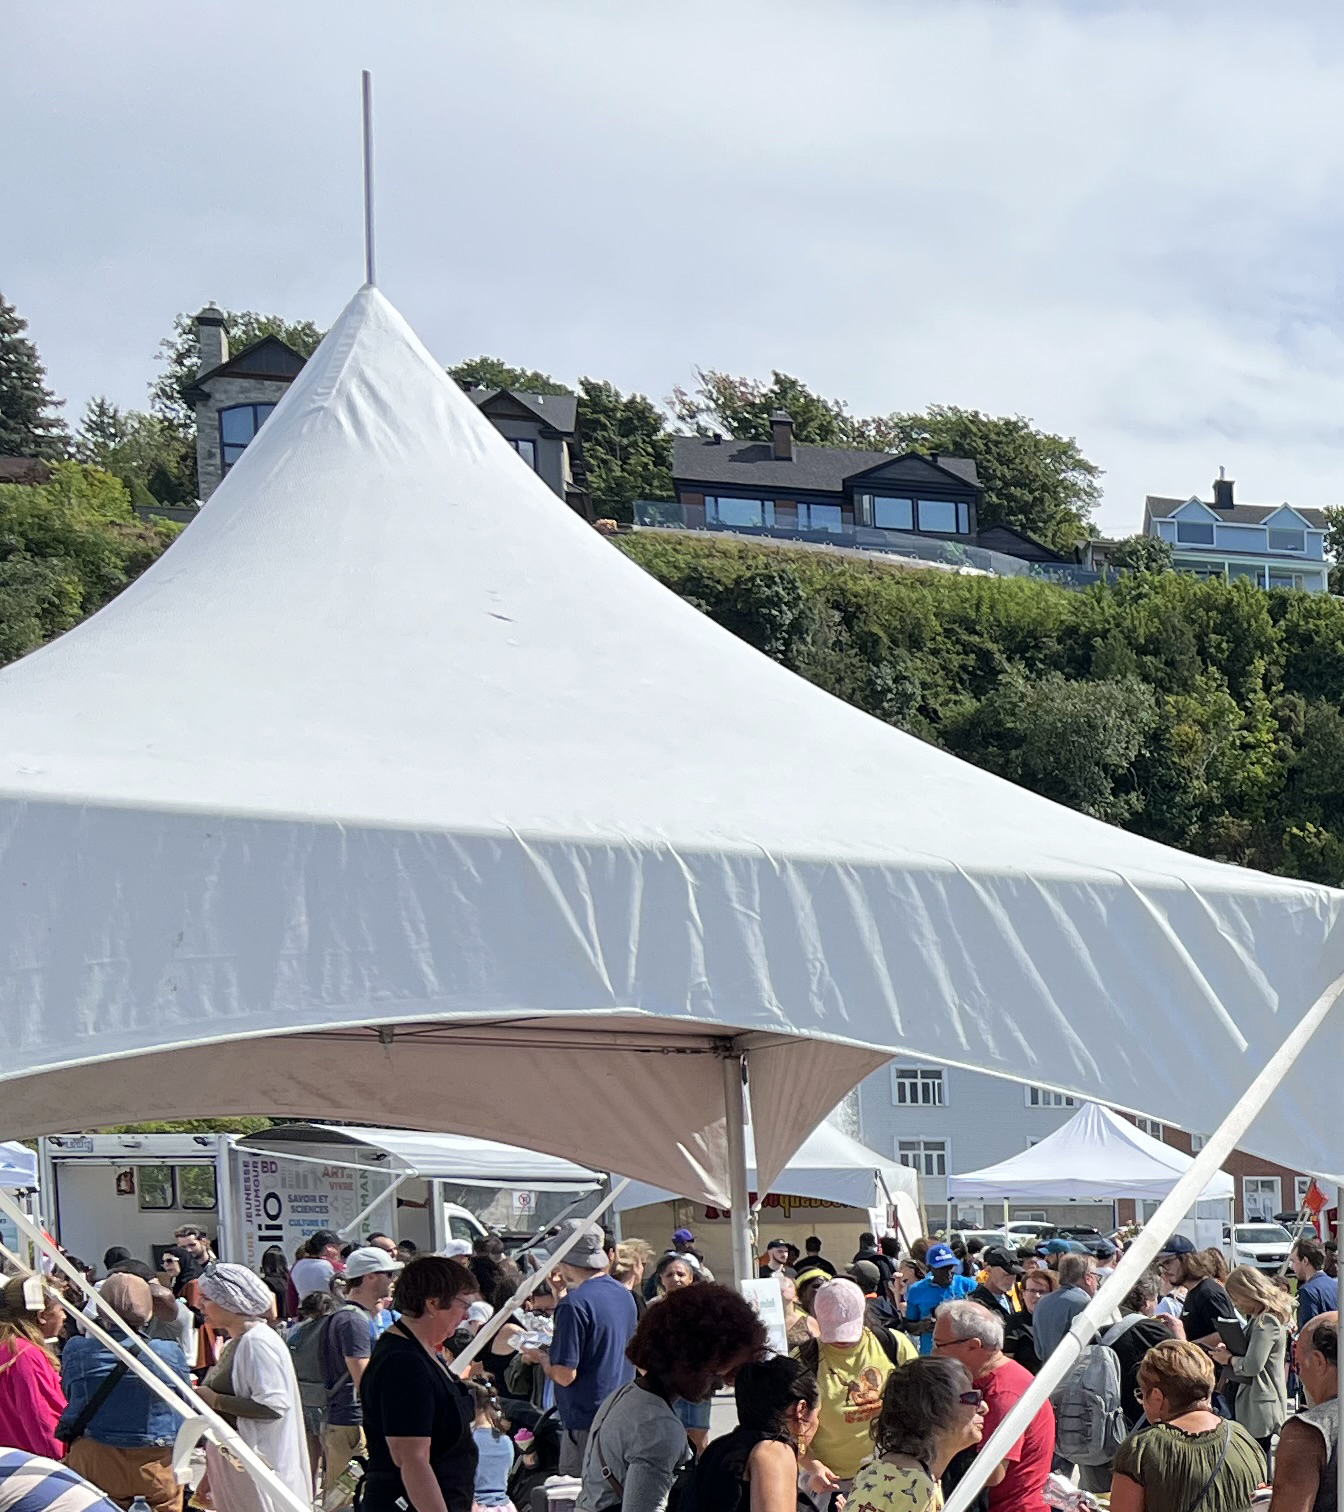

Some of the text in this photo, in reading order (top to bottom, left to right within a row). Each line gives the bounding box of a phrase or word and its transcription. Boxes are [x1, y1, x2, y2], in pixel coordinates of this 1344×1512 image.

[261, 1161, 278, 1174] BD
[322, 1166, 346, 1179] ART
[243, 1160, 253, 1225] JEUNESSE
[252, 1161, 262, 1217] HUMOUR
[328, 1182, 354, 1191] VIVRE
[288, 1194, 329, 1203] SAVOIR ET
[290, 1205, 329, 1214] SCIENCES
